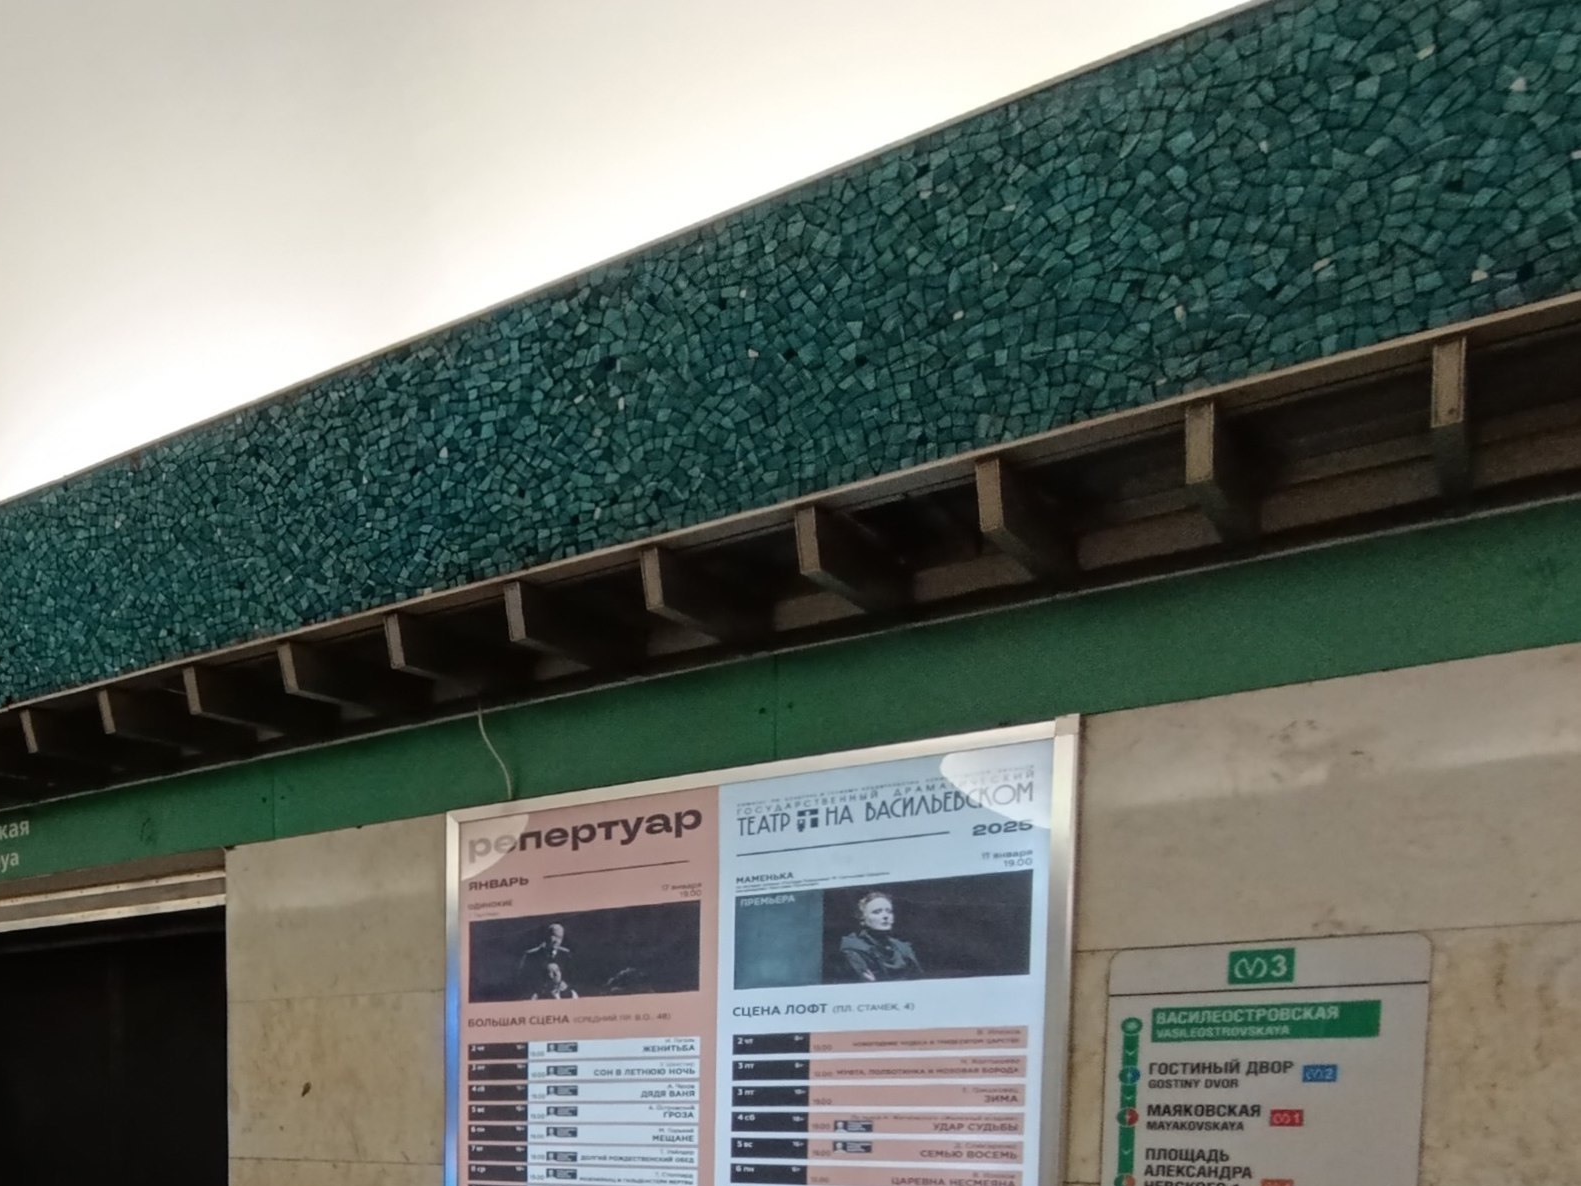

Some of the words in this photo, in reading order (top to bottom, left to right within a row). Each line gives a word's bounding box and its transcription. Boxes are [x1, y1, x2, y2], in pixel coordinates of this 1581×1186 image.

[737, 812, 791, 836] ТЕАТР
[825, 804, 854, 826] НА
[865, 781, 1034, 822] ВАСИЛЬЕВСКОМ
[972, 818, 1033, 836] 2025
[468, 809, 703, 865] репертуар
[468, 876, 529, 891] ЯНВАРЬ
[736, 872, 794, 884] МАМЕНЬКА
[1271, 954, 1288, 978] 3
[733, 1006, 781, 1018] СЦЕНА
[784, 1003, 828, 1015] ЛОФТ
[1156, 1006, 1339, 1025] ВАСИЛЕОСТРОВСКАЯ
[468, 1016, 527, 1028] БОЛЬШАЯ
[529, 1015, 570, 1027] СЦЕНА
[1156, 1025, 1290, 1038] VASILEOSTROVSKAYA
[642, 1044, 695, 1052] ЖЕНИТЬБА
[593, 1068, 613, 1076] СОН
[624, 1068, 666, 1076] ЛЕТНЮЮ
[668, 1067, 696, 1075] НОЧЬ
[1148, 1058, 1241, 1075] ГОСТИНЫЙ
[1245, 1060, 1294, 1077] ДВОР
[1148, 1079, 1200, 1089] GOSTINY
[1204, 1078, 1239, 1089] DVOR
[668, 1090, 696, 1098] ВАНЯ
[663, 1111, 694, 1119] ГРОЗА
[1147, 1104, 1261, 1118] МАЯКОВСКАЯ
[1146, 1120, 1244, 1131] MAYAKOVSKAYA
[967, 1150, 1017, 1160] ВОСЕМЬ
[1145, 1148, 1230, 1163] ПЛОЩАДЬ
[1144, 1164, 1253, 1180] АЛЕКСАНДРА
